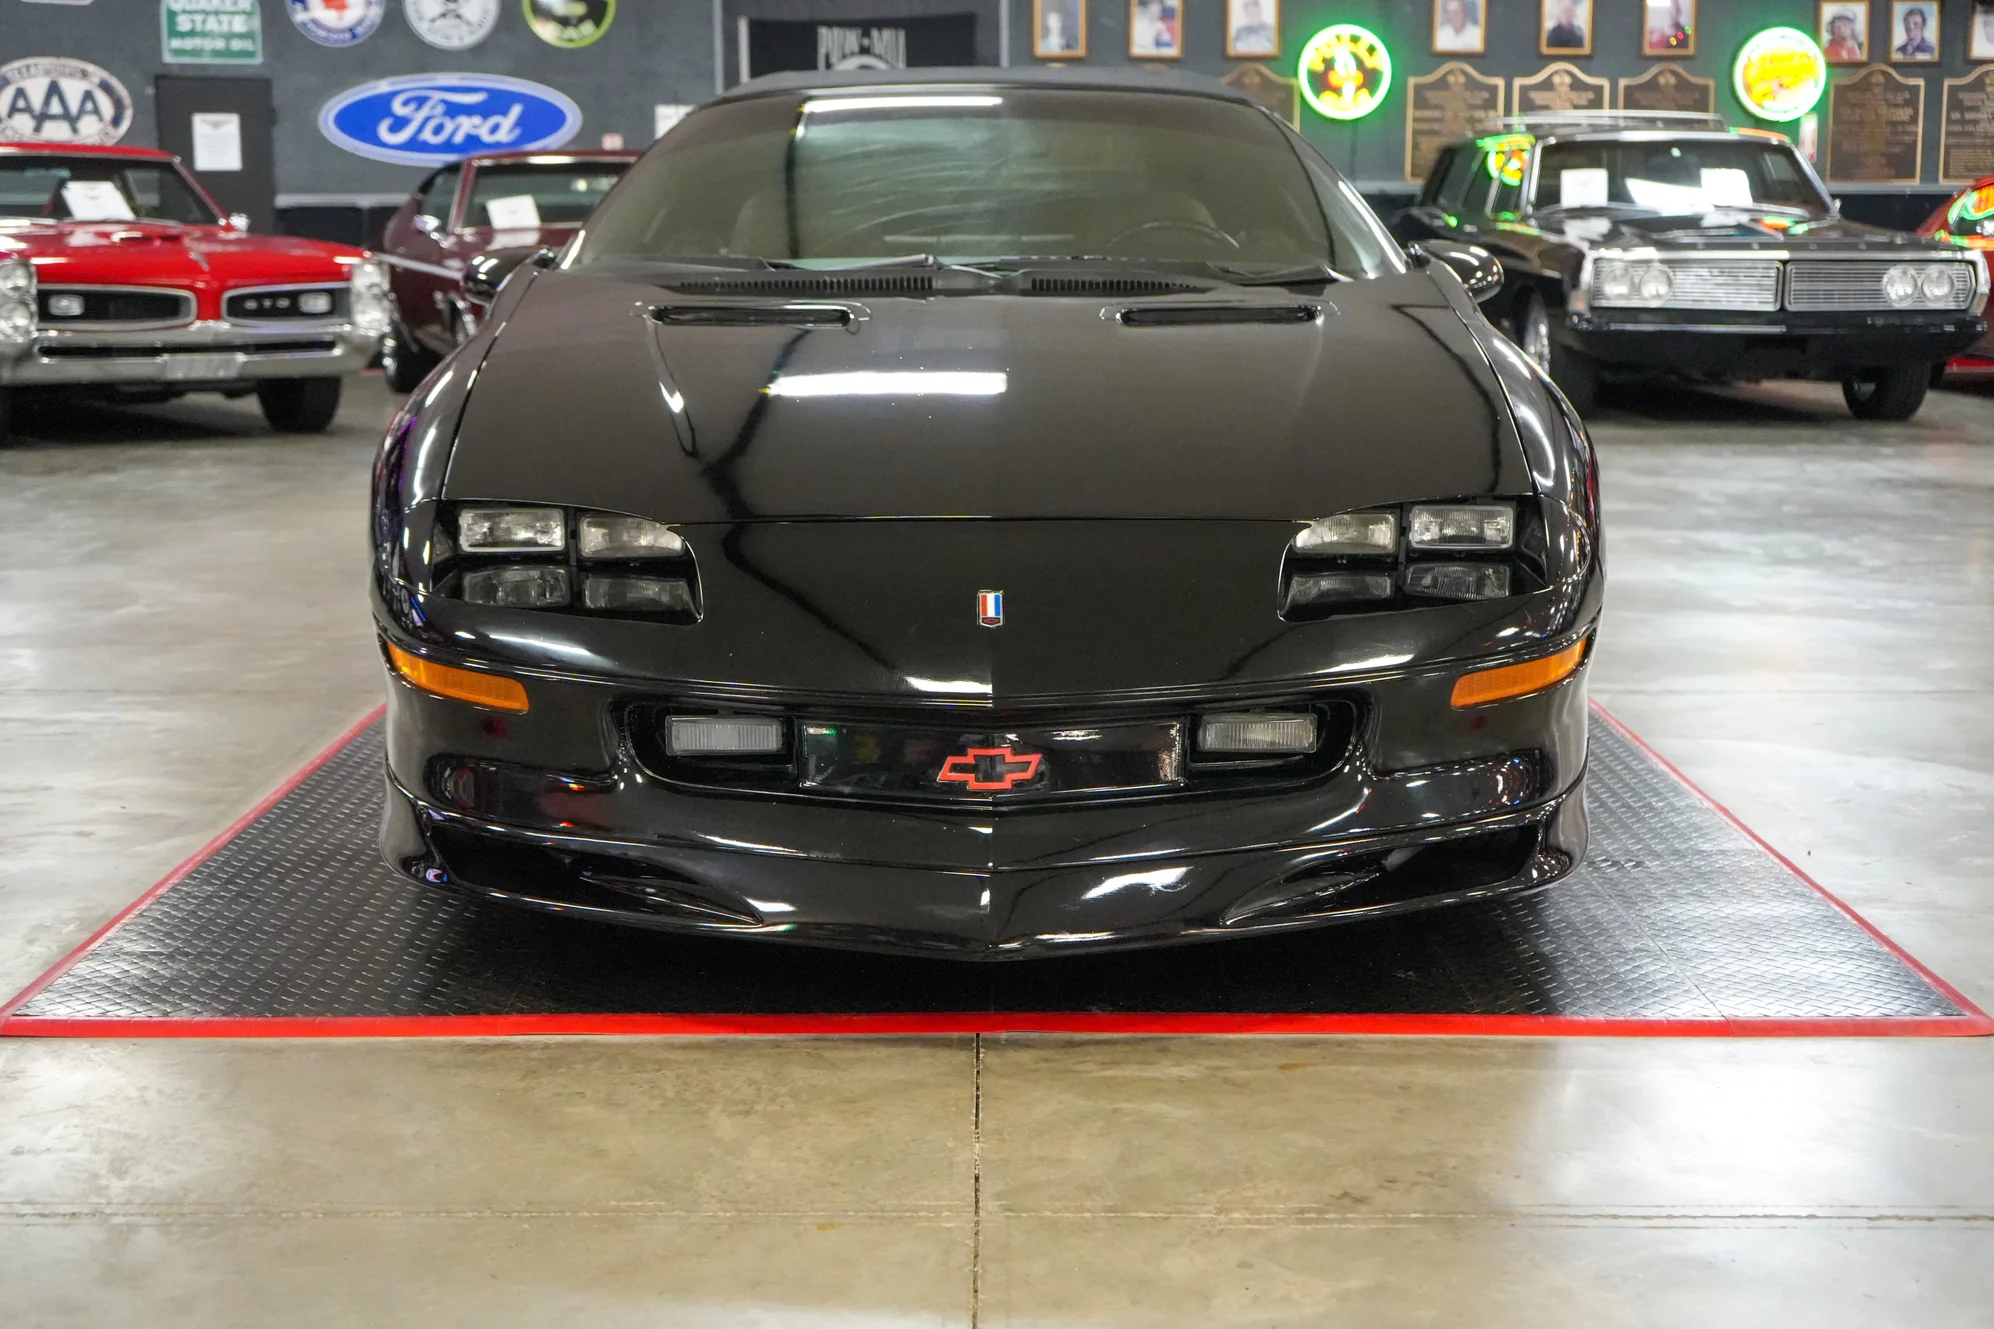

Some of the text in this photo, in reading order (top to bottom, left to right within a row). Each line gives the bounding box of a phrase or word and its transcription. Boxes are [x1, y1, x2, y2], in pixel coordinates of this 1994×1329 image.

[175, 13, 248, 33] STATE
[170, 37, 255, 51] MOTOR OIL
[7, 79, 104, 134] AAA
[376, 89, 523, 145] Ford
